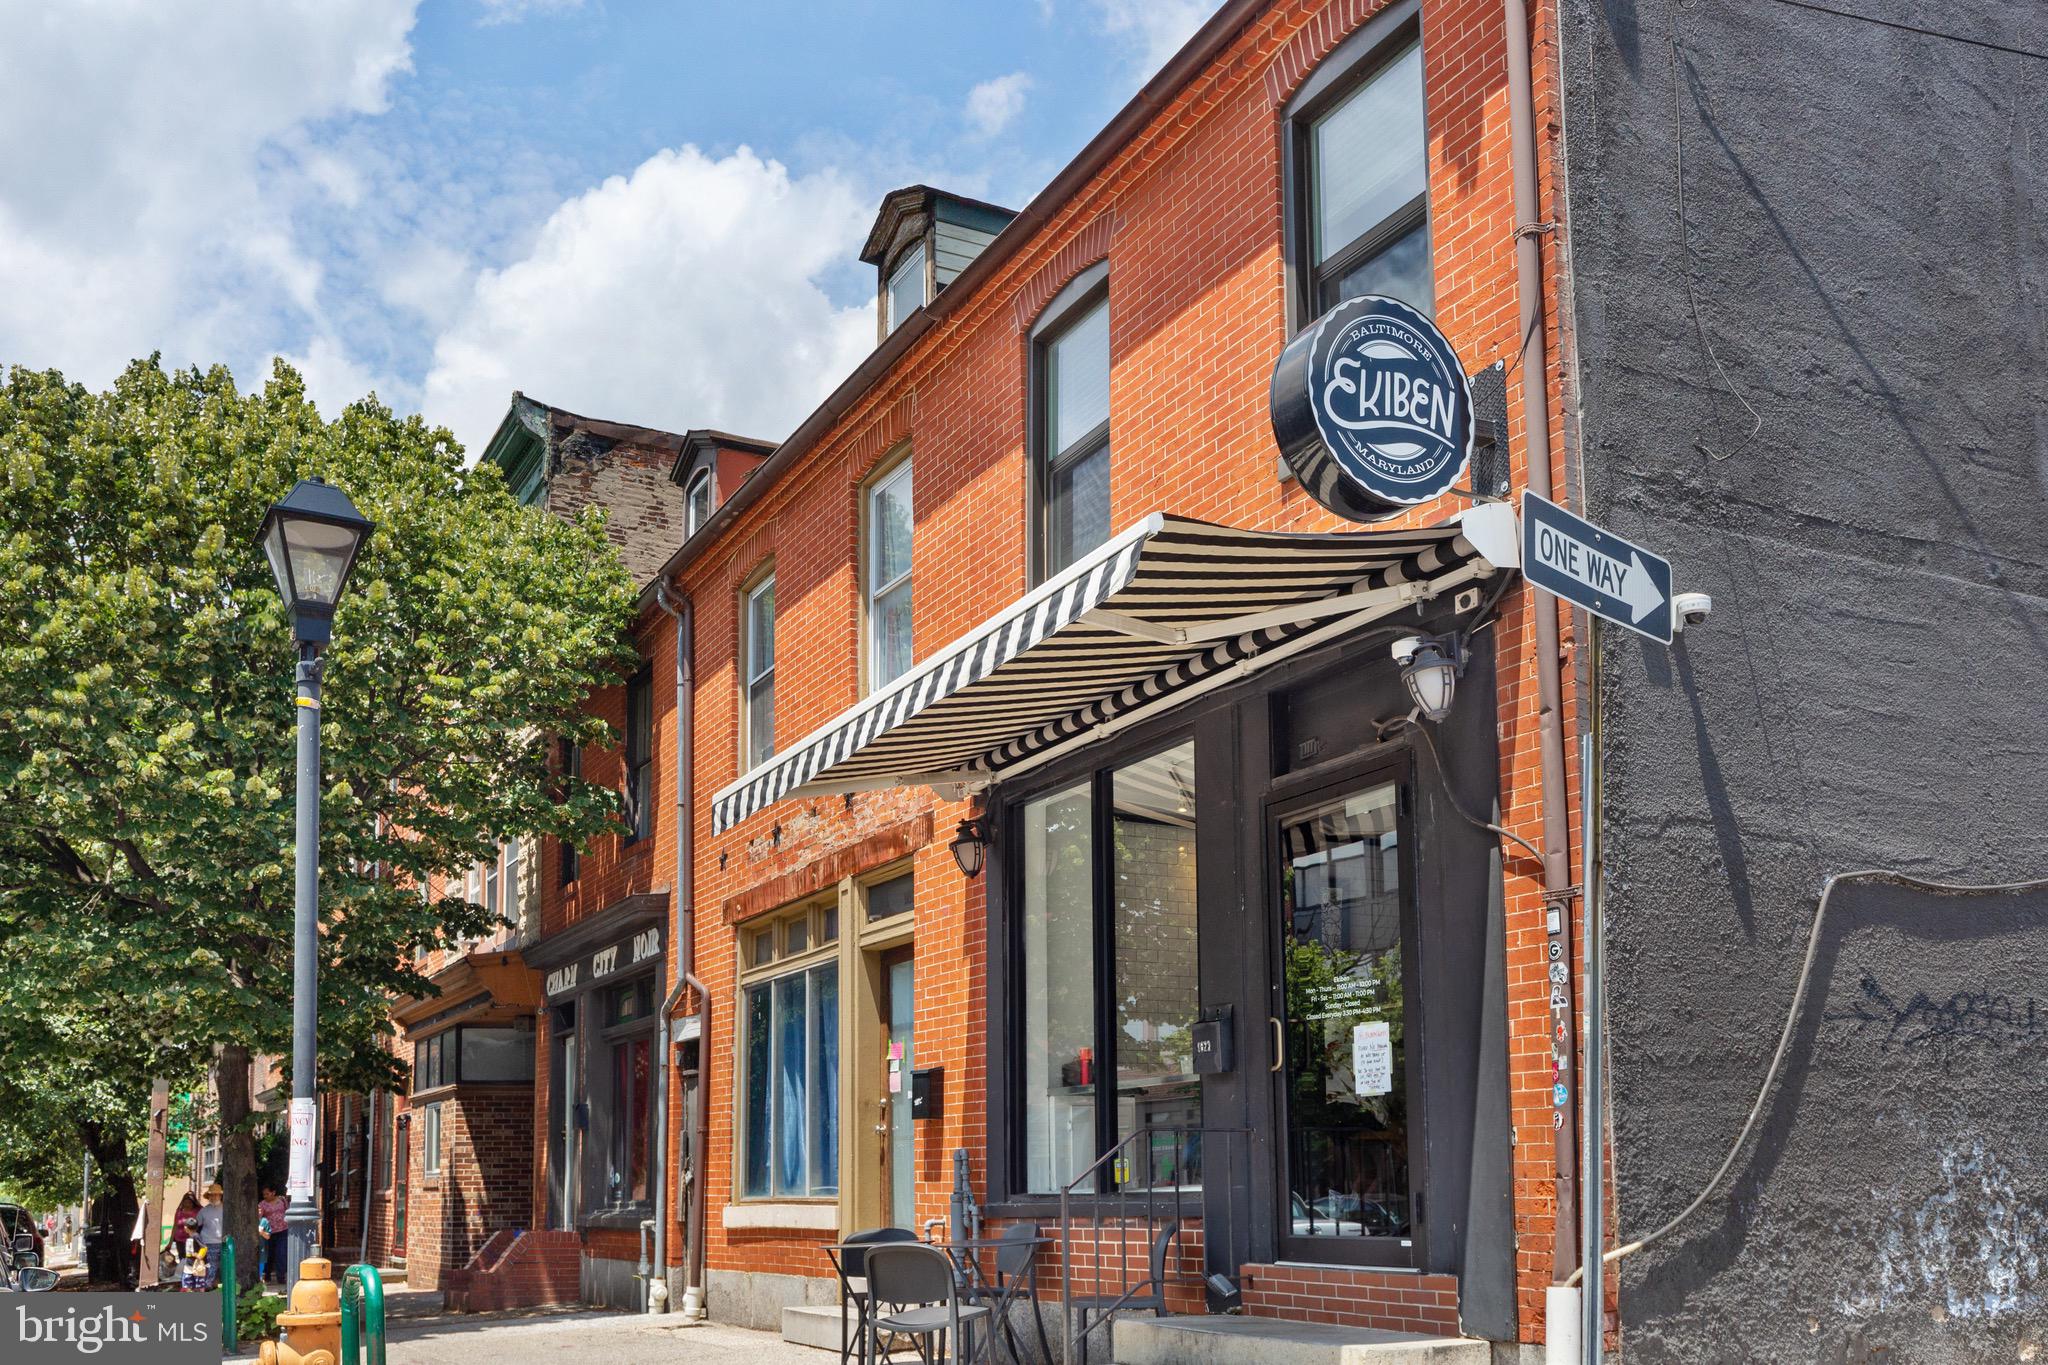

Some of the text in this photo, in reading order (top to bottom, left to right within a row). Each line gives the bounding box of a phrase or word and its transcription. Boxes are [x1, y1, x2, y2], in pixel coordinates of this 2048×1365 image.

[1350, 324, 1432, 362] BALTIMORE
[1324, 358, 1456, 449] EKIBEN
[1354, 440, 1435, 475] MARYLAND
[1540, 528, 1627, 597] ONE WAY
[546, 928, 660, 996] CHARM CITY NOIR
